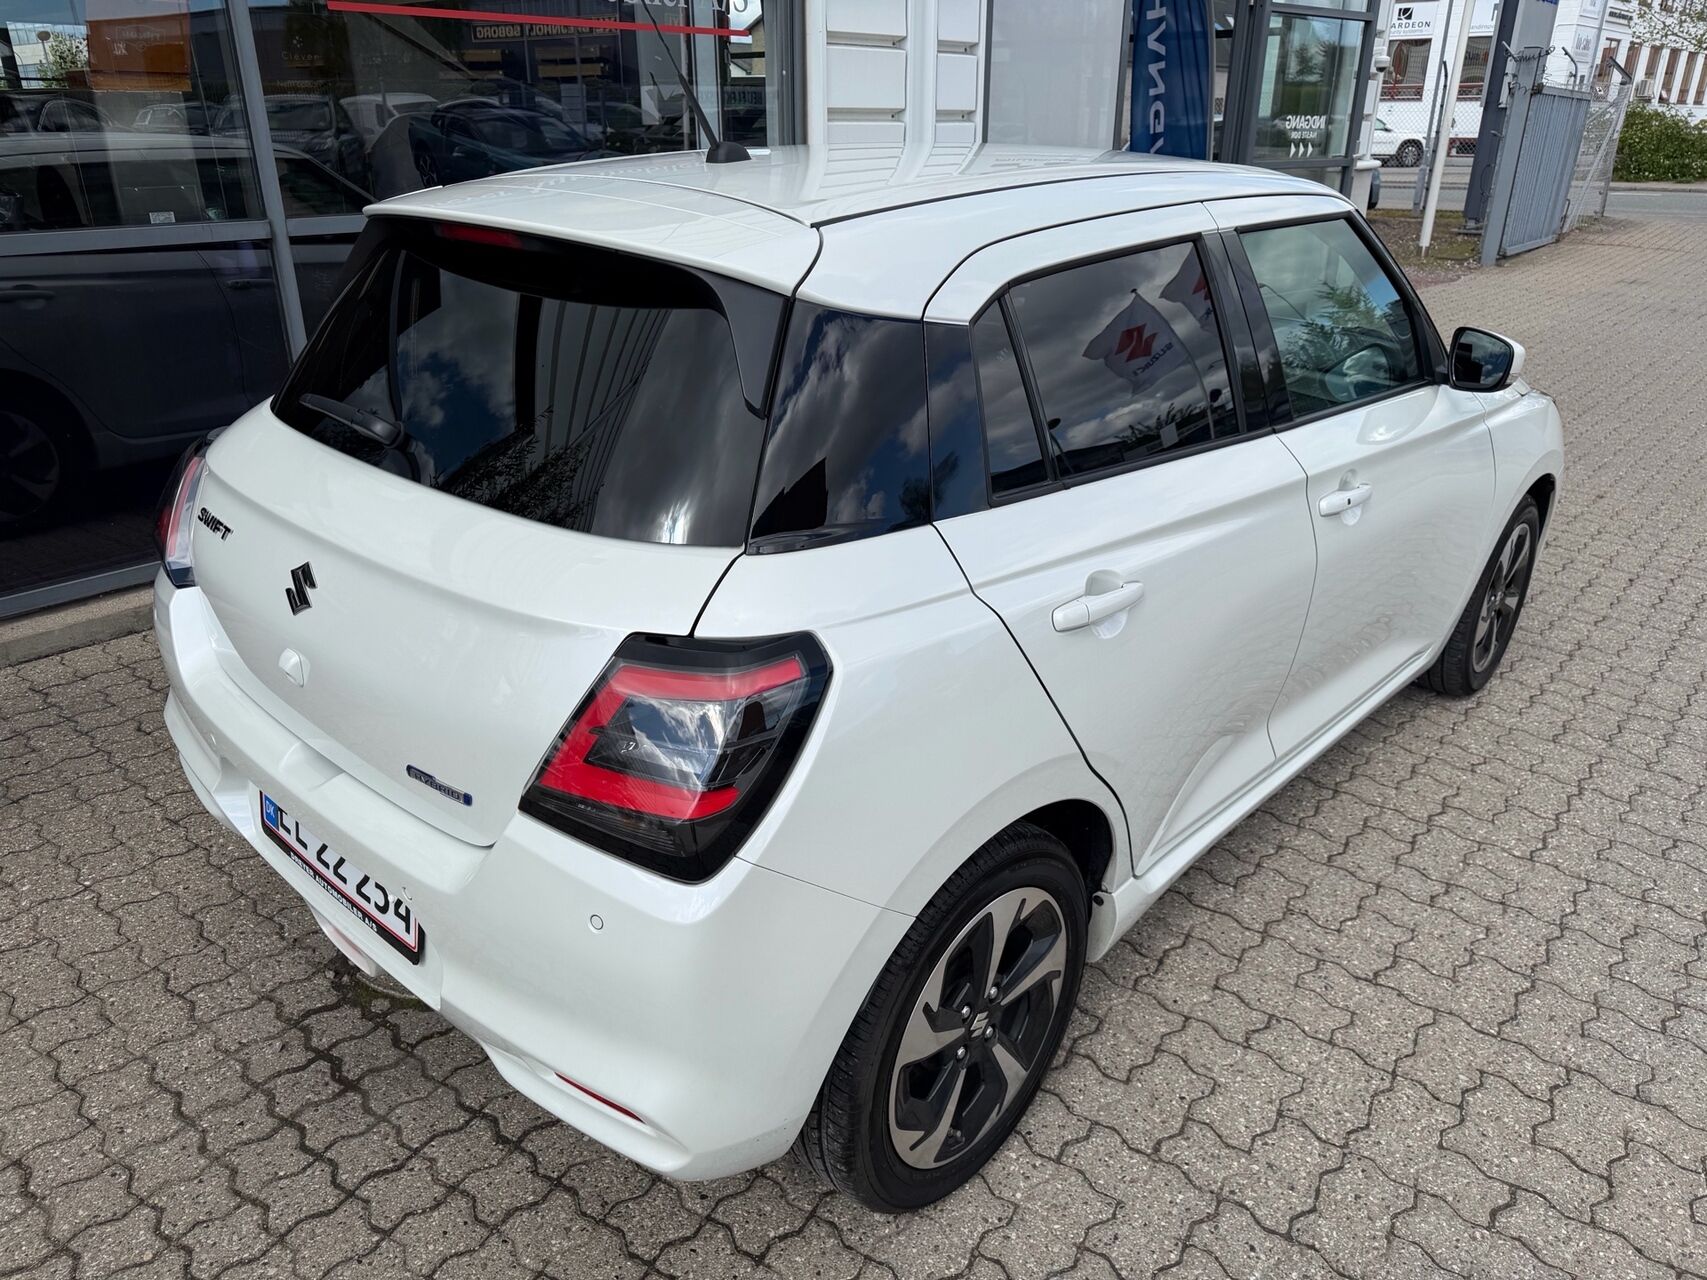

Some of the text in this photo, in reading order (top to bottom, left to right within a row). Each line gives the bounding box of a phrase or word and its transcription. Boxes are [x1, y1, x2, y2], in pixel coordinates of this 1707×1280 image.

[198, 506, 233, 541] SWIFT
[411, 769, 462, 801] HYBRID
[265, 800, 275, 817] DK
[315, 875, 364, 923] AUTOMOBILER
[364, 913, 378, 932] A/S
